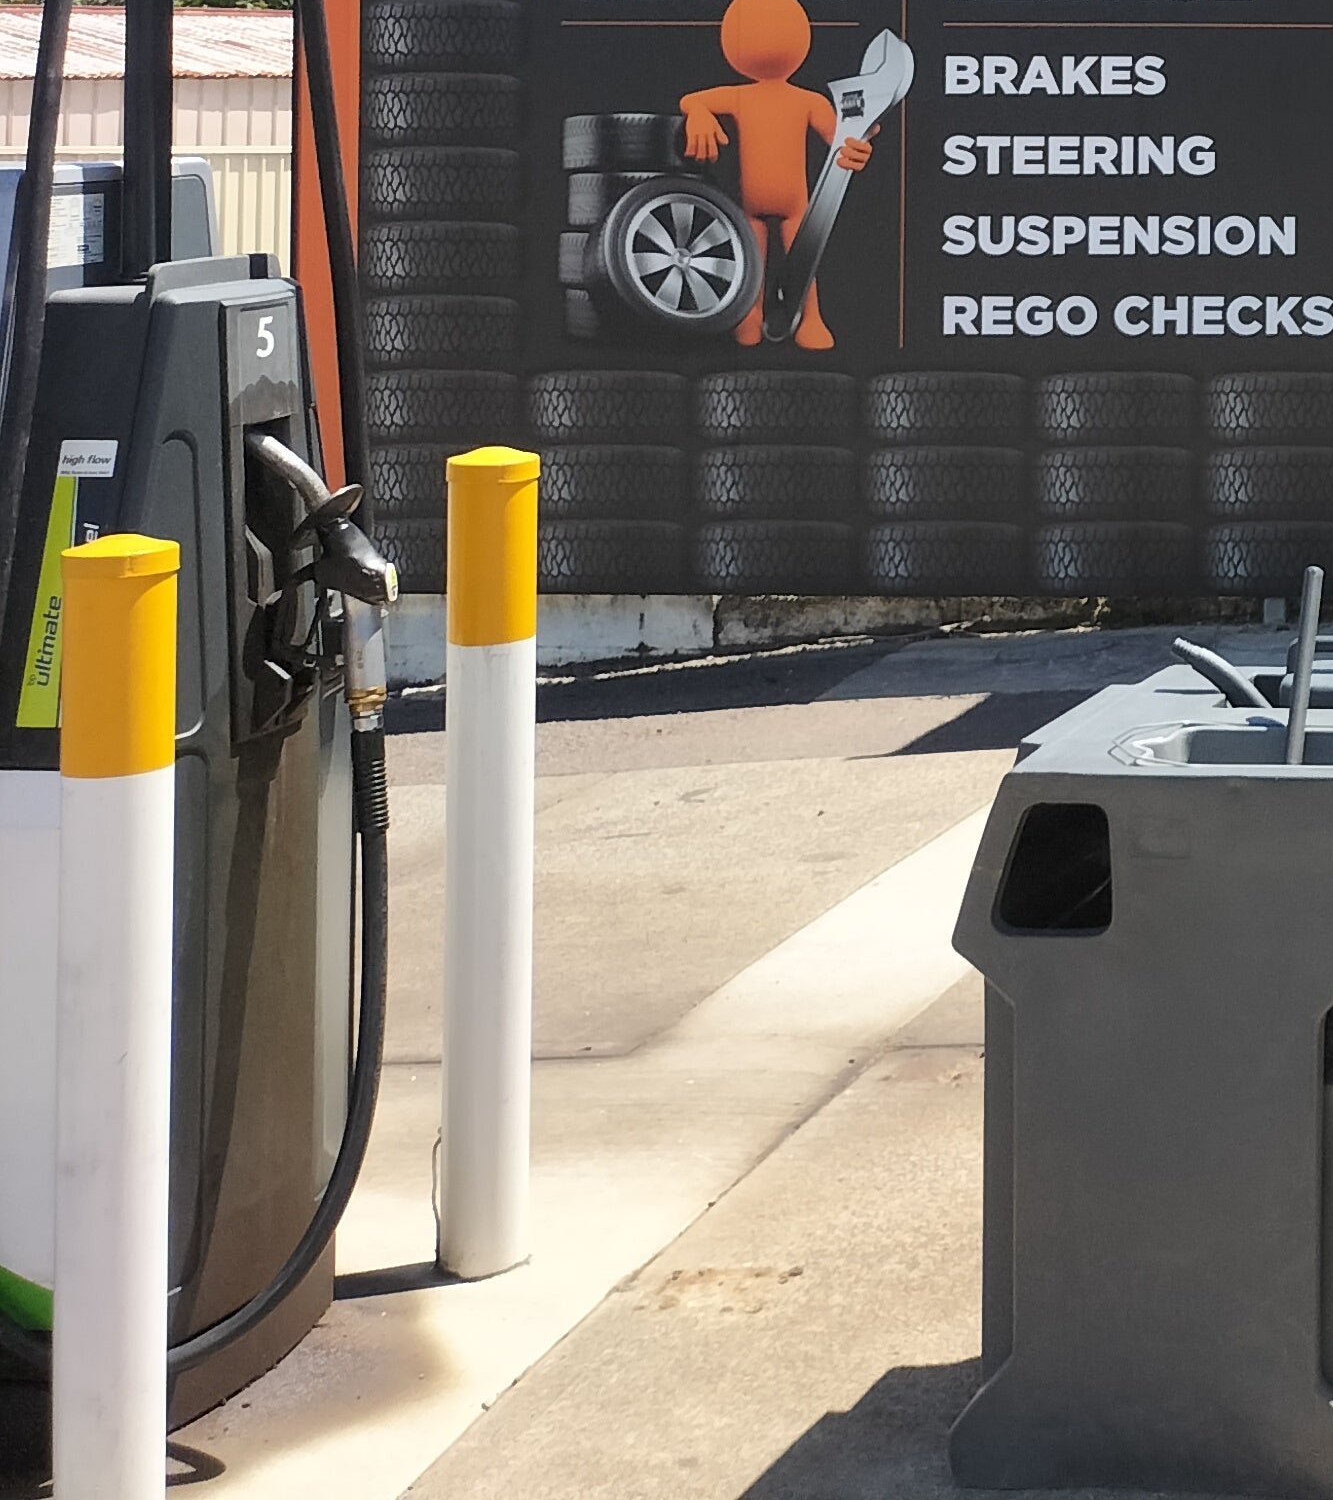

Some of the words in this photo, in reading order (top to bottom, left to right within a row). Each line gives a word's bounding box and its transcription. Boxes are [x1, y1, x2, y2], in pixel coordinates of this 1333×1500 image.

[943, 55, 1167, 96] BRAKES
[943, 134, 1217, 176] STEERING
[941, 215, 1297, 257] SUSPENSION
[256, 316, 275, 358] 5
[942, 295, 1099, 338] REGO
[62, 454, 85, 466] high
[87, 454, 112, 465] flow
[35, 595, 62, 687] ultimate
